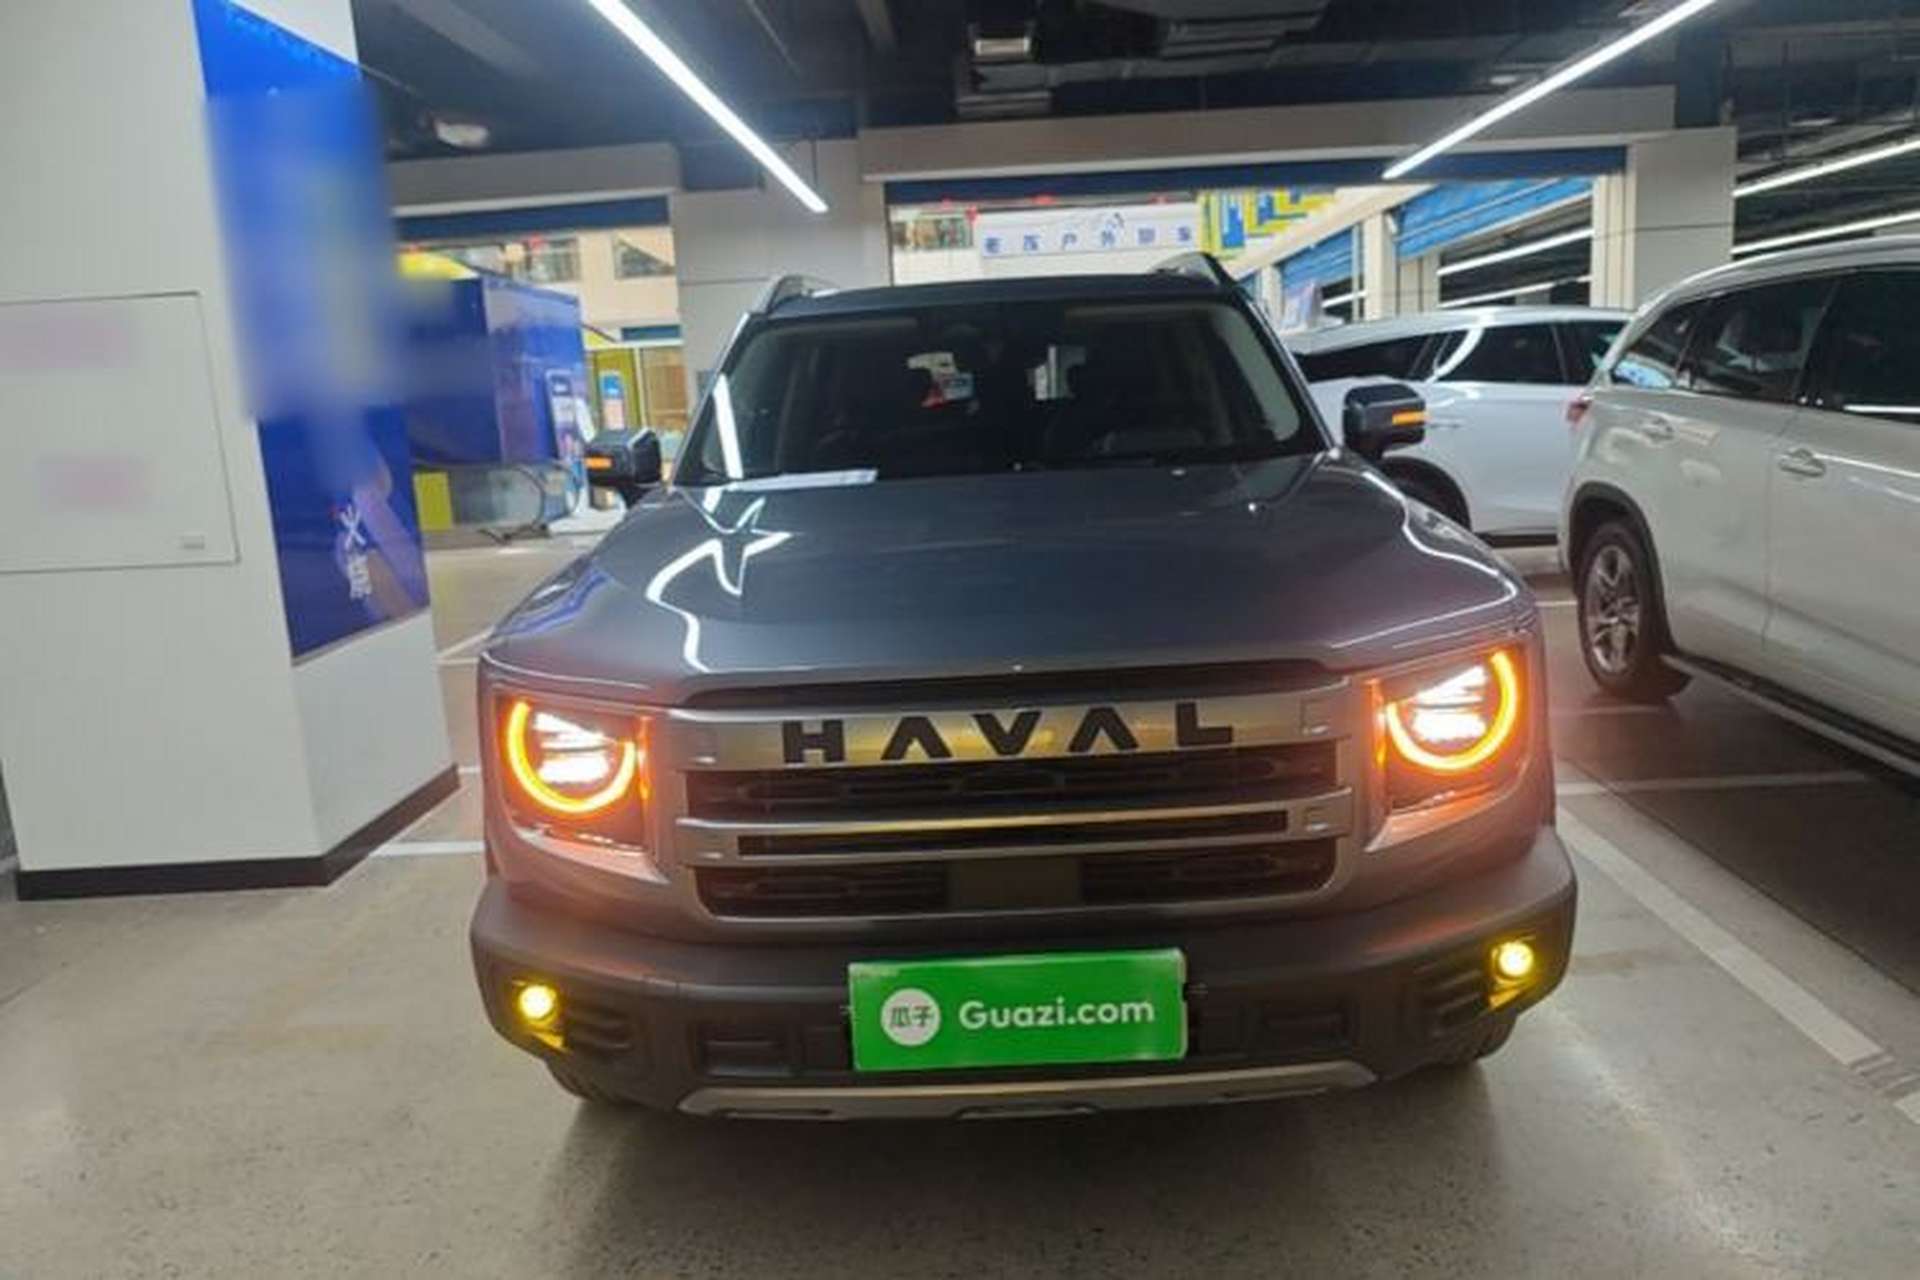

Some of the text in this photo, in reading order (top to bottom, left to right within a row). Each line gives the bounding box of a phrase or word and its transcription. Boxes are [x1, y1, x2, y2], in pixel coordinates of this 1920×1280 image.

[781, 701, 1235, 764] HAVAL
[889, 997, 1155, 1031] 瓜子 Guazi.com
